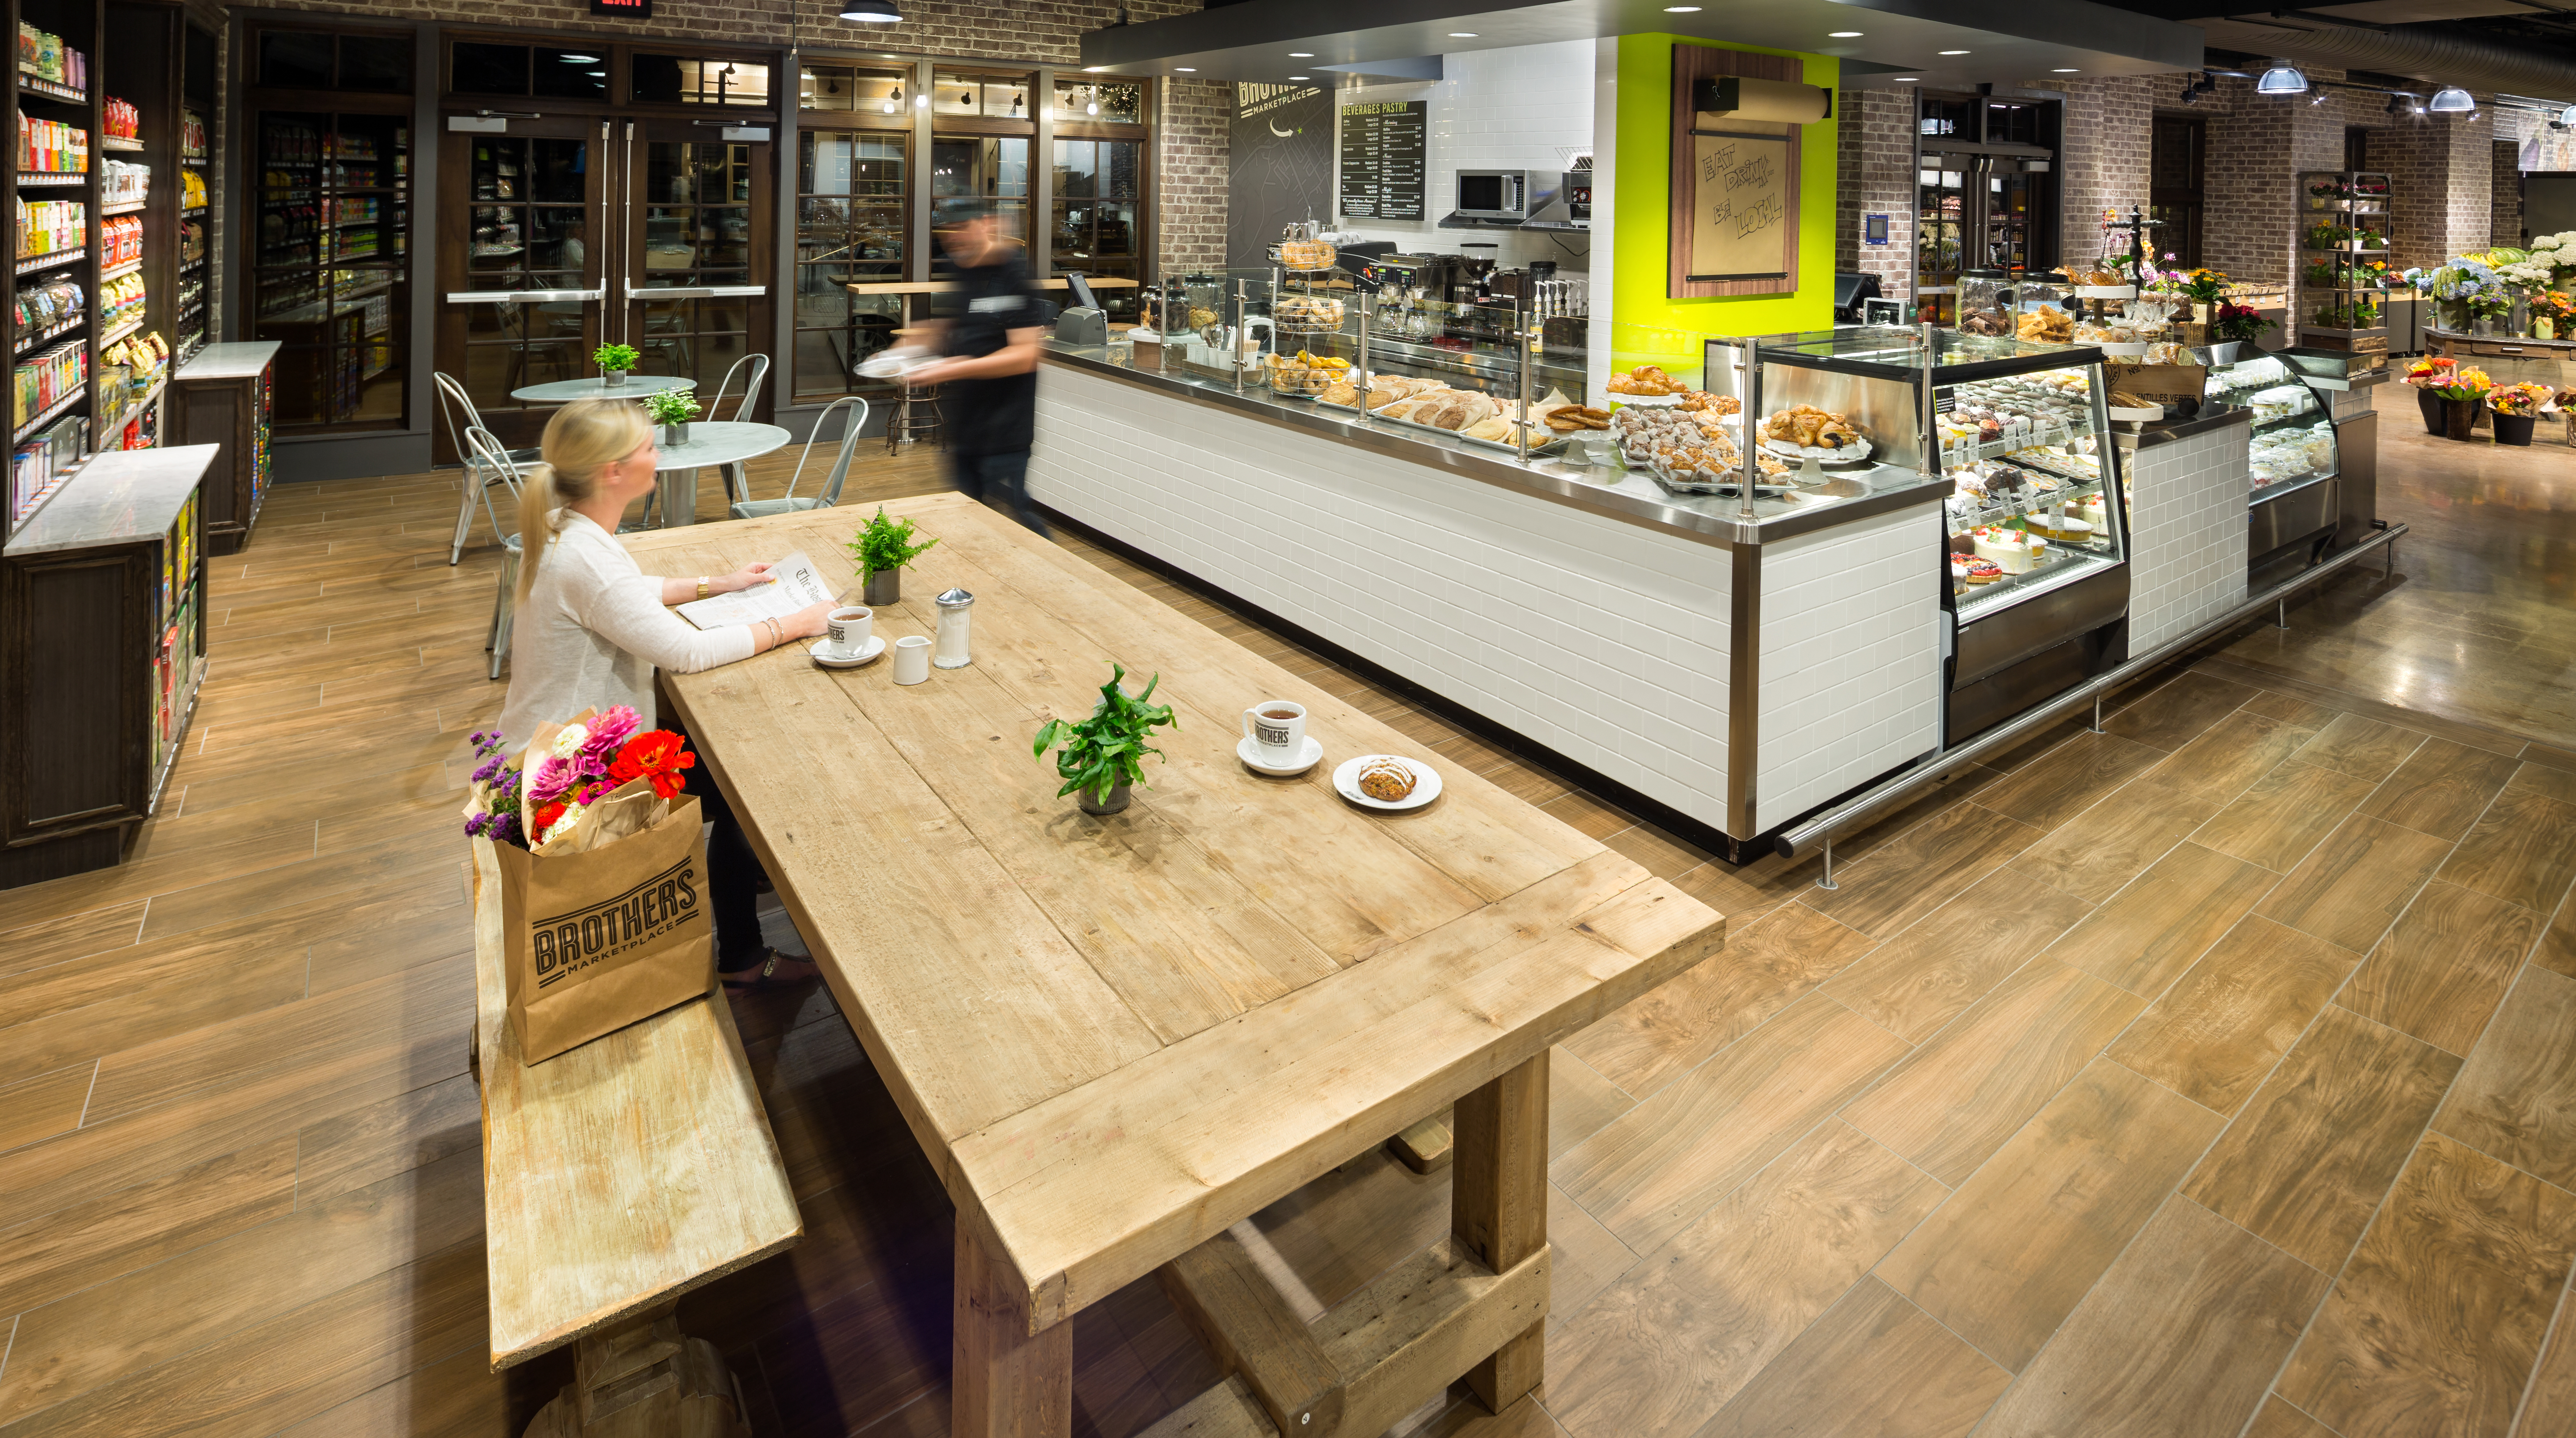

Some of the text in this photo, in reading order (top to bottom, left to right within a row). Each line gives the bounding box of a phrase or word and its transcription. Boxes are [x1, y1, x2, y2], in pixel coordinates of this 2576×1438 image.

[1253, 90, 1306, 114] MARKETPLACE
[1343, 103, 1380, 116] BEVERAGES
[1382, 102, 1408, 113] PASTRY
[2521, 112, 2538, 123] EGGPLANT
[1702, 143, 1735, 182] EAT
[1713, 198, 1731, 225] BE
[1734, 192, 1782, 239] LOCAL
[2133, 393, 2168, 402] ENTILLES
[796, 568, 810, 588] The
[828, 626, 844, 641] THERS
[534, 869, 696, 976] BROTHERS
[568, 921, 673, 975] MARKETPLACE
